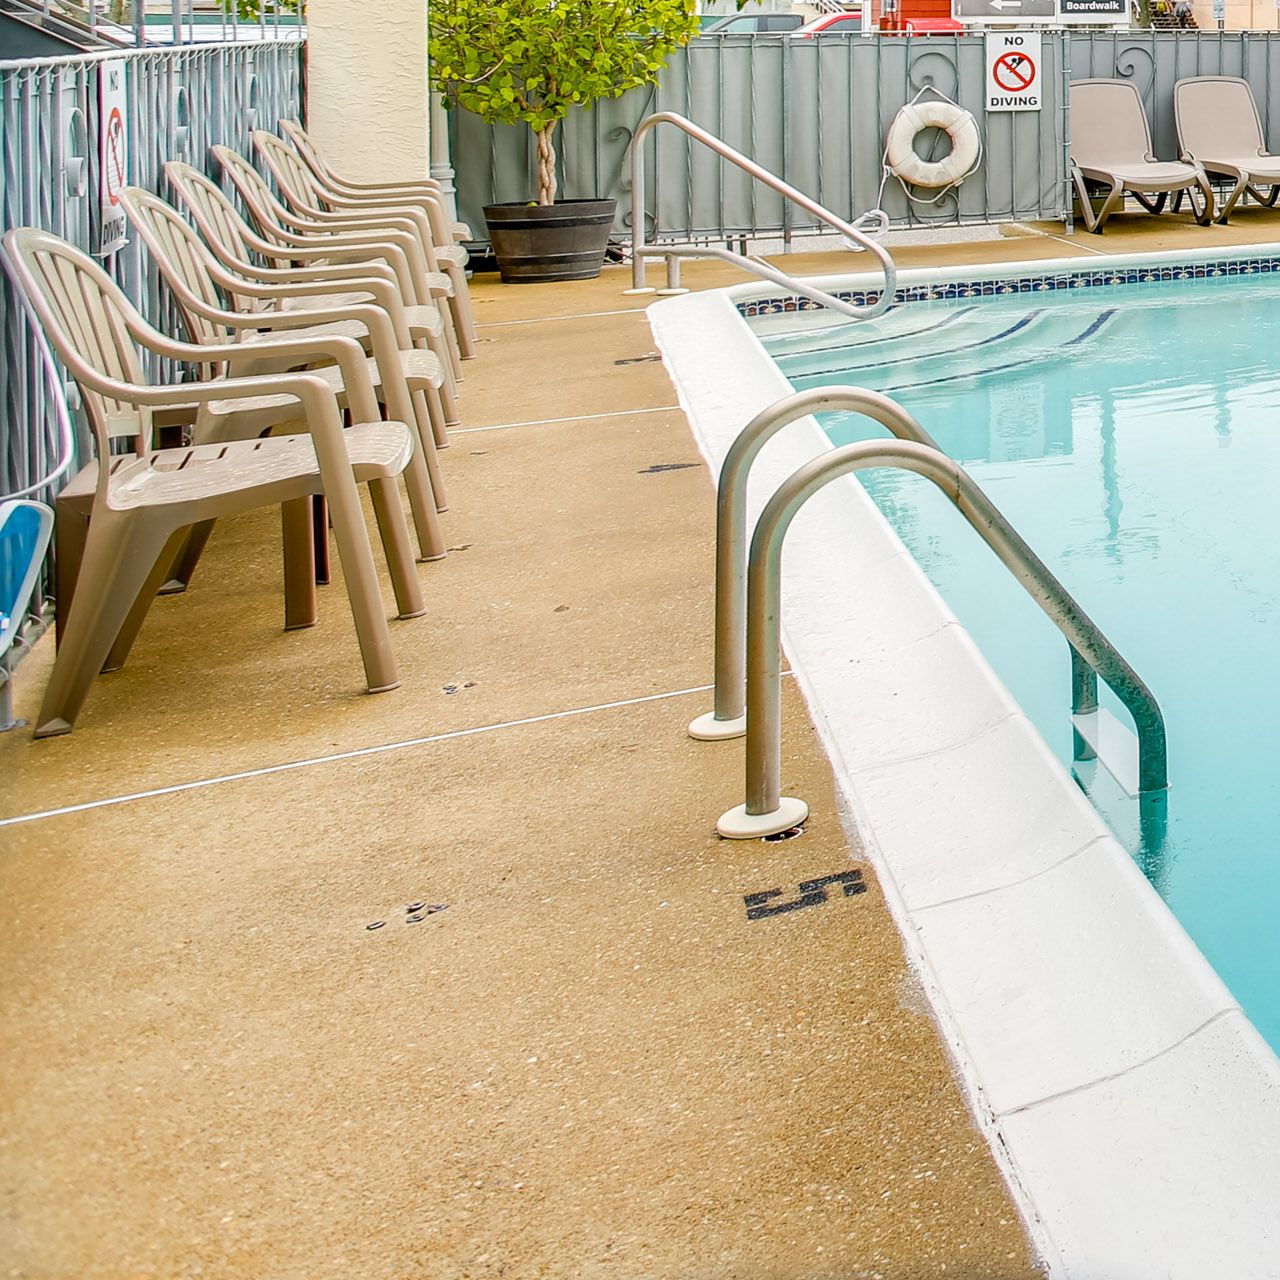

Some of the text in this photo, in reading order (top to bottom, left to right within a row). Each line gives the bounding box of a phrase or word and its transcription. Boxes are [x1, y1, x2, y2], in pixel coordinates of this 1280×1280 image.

[1066, 0, 1120, 10] Boardwalk
[1004, 36, 1024, 46] NO
[990, 96, 1038, 107] DIVING
